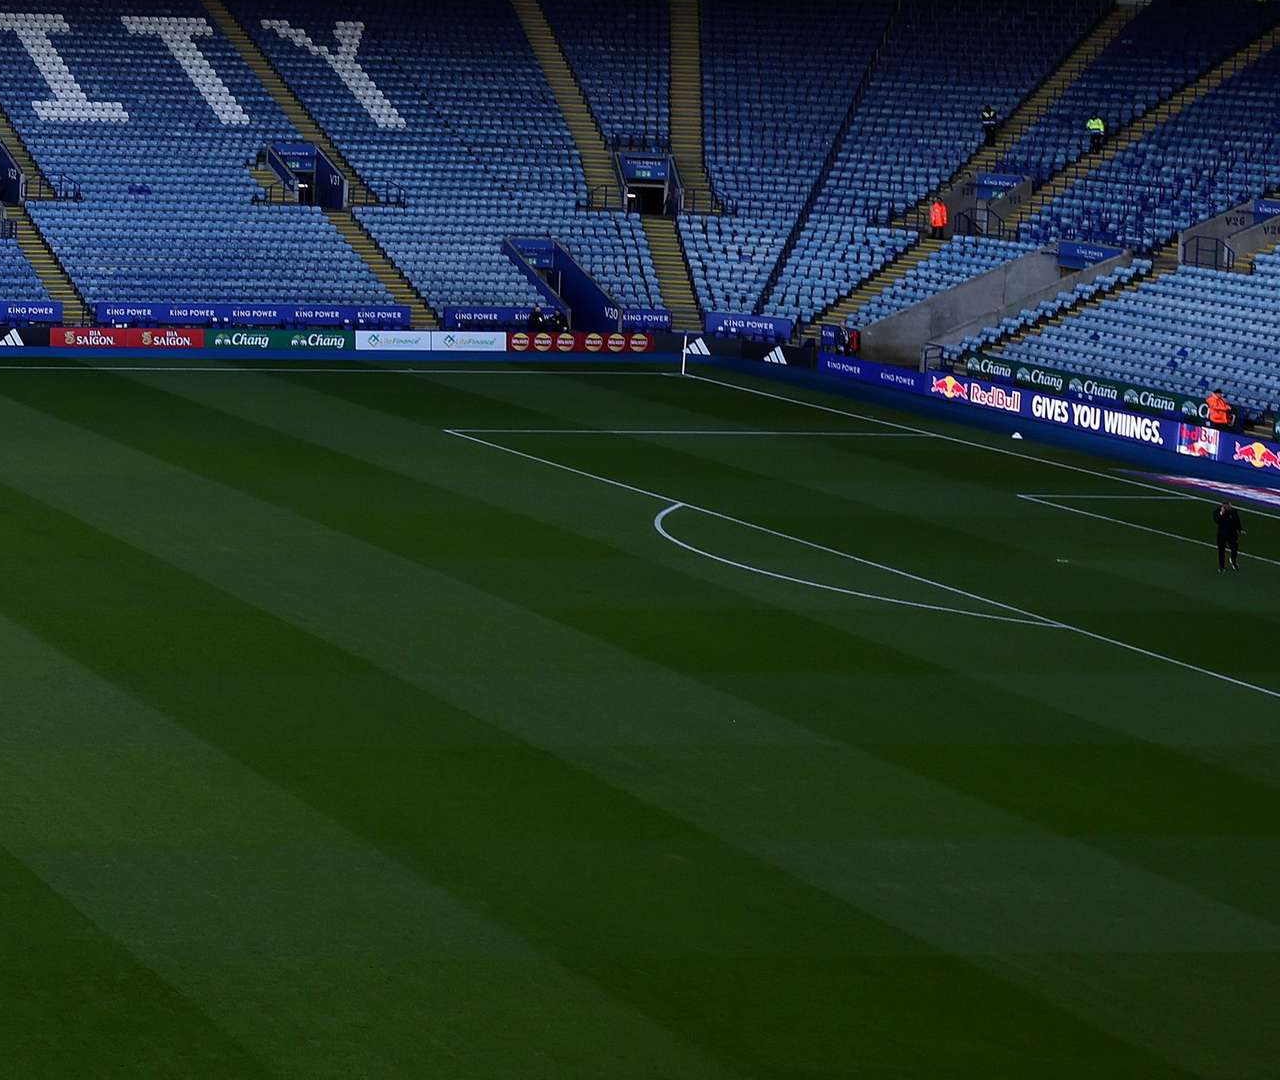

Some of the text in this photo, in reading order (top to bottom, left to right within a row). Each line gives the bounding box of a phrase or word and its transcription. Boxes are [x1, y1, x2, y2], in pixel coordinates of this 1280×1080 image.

[604, 307, 619, 319] V30
[723, 320, 773, 329] KING POWER
[231, 333, 269, 348] Chang
[308, 334, 345, 349] Chang
[827, 361, 860, 374] KING POWER
[880, 372, 914, 386] KING POWER
[1031, 370, 1063, 391] Chang
[1032, 395, 1069, 427] GIVES
[1072, 402, 1101, 431] YOU
[1104, 409, 1164, 445] WIIINGS.
